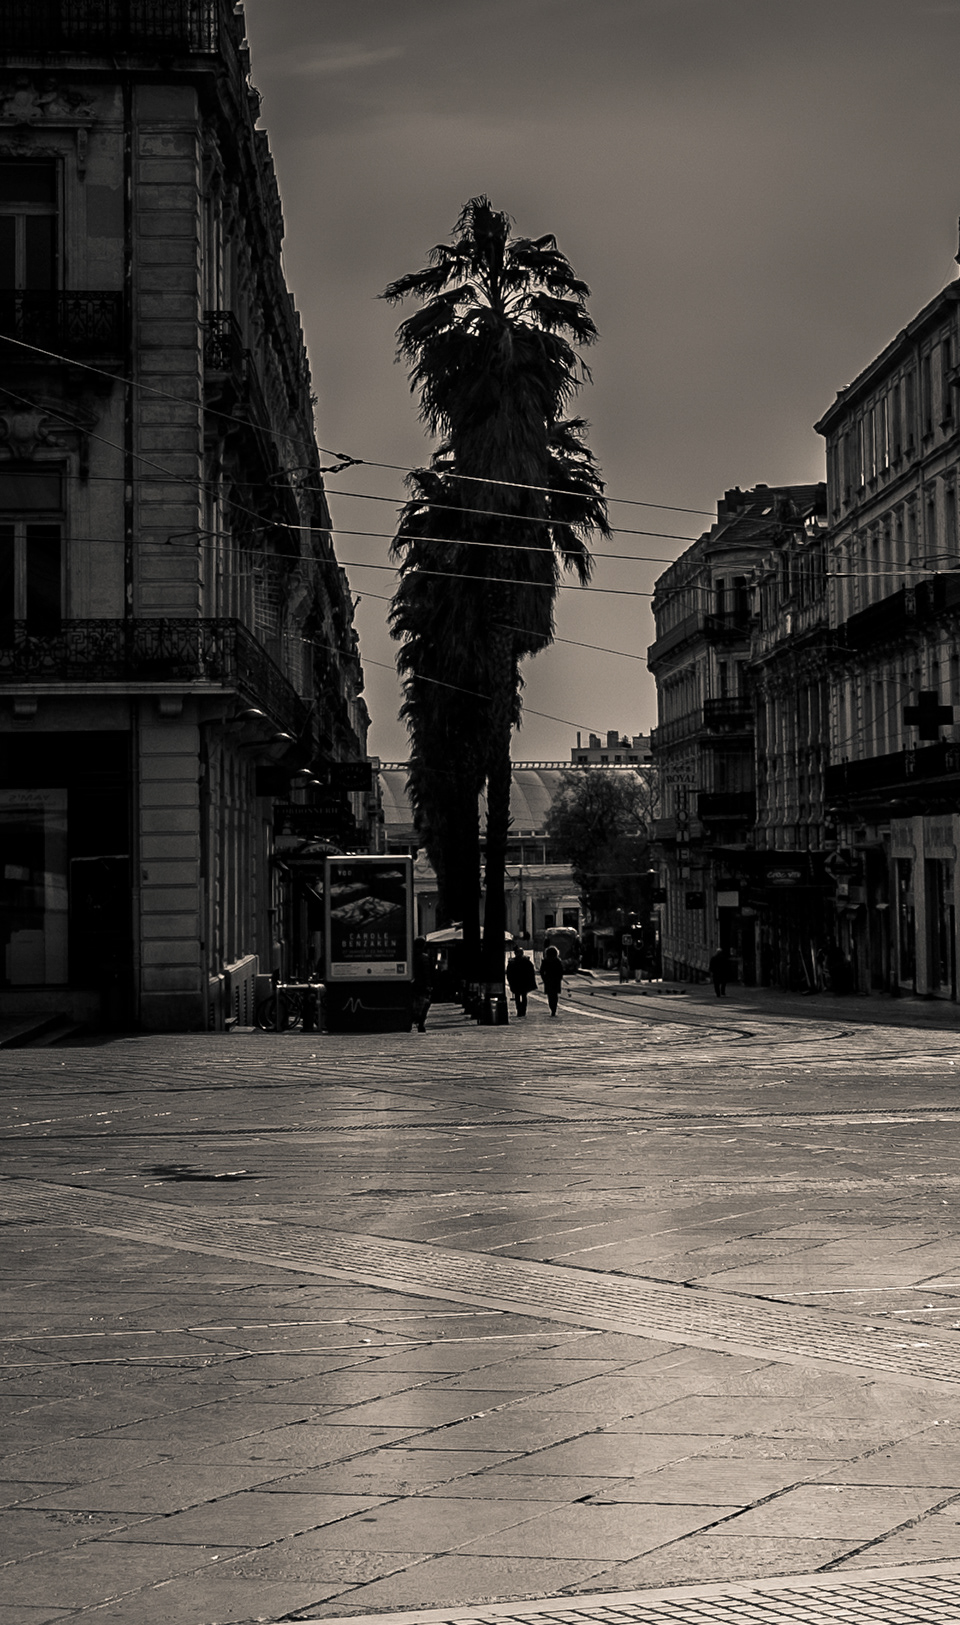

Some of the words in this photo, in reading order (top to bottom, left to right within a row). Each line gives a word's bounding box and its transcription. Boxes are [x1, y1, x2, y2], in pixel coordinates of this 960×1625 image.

[666, 775, 695, 784] ROYAL
[676, 791, 690, 879] HOTEL
[349, 932, 389, 940] CAROLE
[341, 939, 397, 948] BENZAKEN
